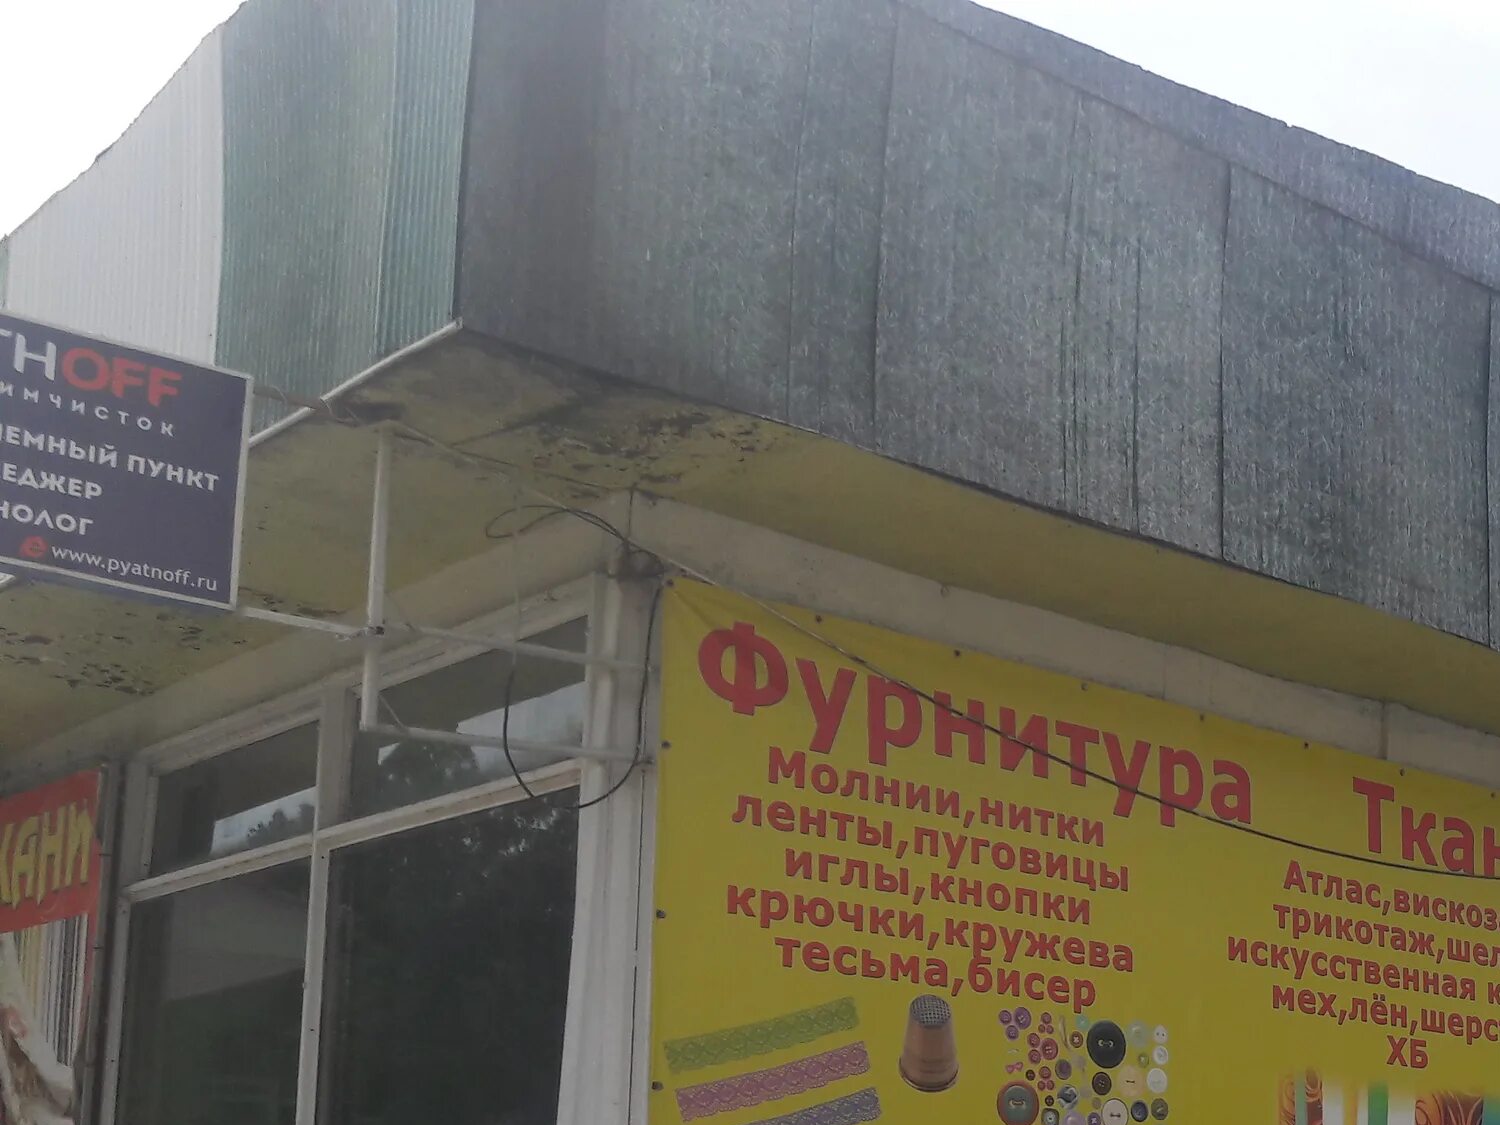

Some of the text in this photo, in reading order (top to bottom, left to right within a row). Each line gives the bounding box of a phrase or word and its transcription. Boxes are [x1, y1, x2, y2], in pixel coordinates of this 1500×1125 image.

[0, 422, 219, 492] ЕМНЫЙ ПУНКТ
[2, 462, 103, 499] ЕДЖЕР
[51, 545, 218, 592] www.pyatnoff.ru
[698, 622, 1252, 827] Фурнитура
[768, 747, 1104, 847] Молнии,нитки
[732, 795, 1129, 891] ленты,пуговицы
[784, 849, 1090, 925] иглы,кнопки
[727, 885, 1134, 972] крючки,кружева
[775, 934, 1096, 1012] тесьма,бисер
[1227, 936, 1475, 1001] искусственная
[1386, 1035, 1428, 1068] ХБ
